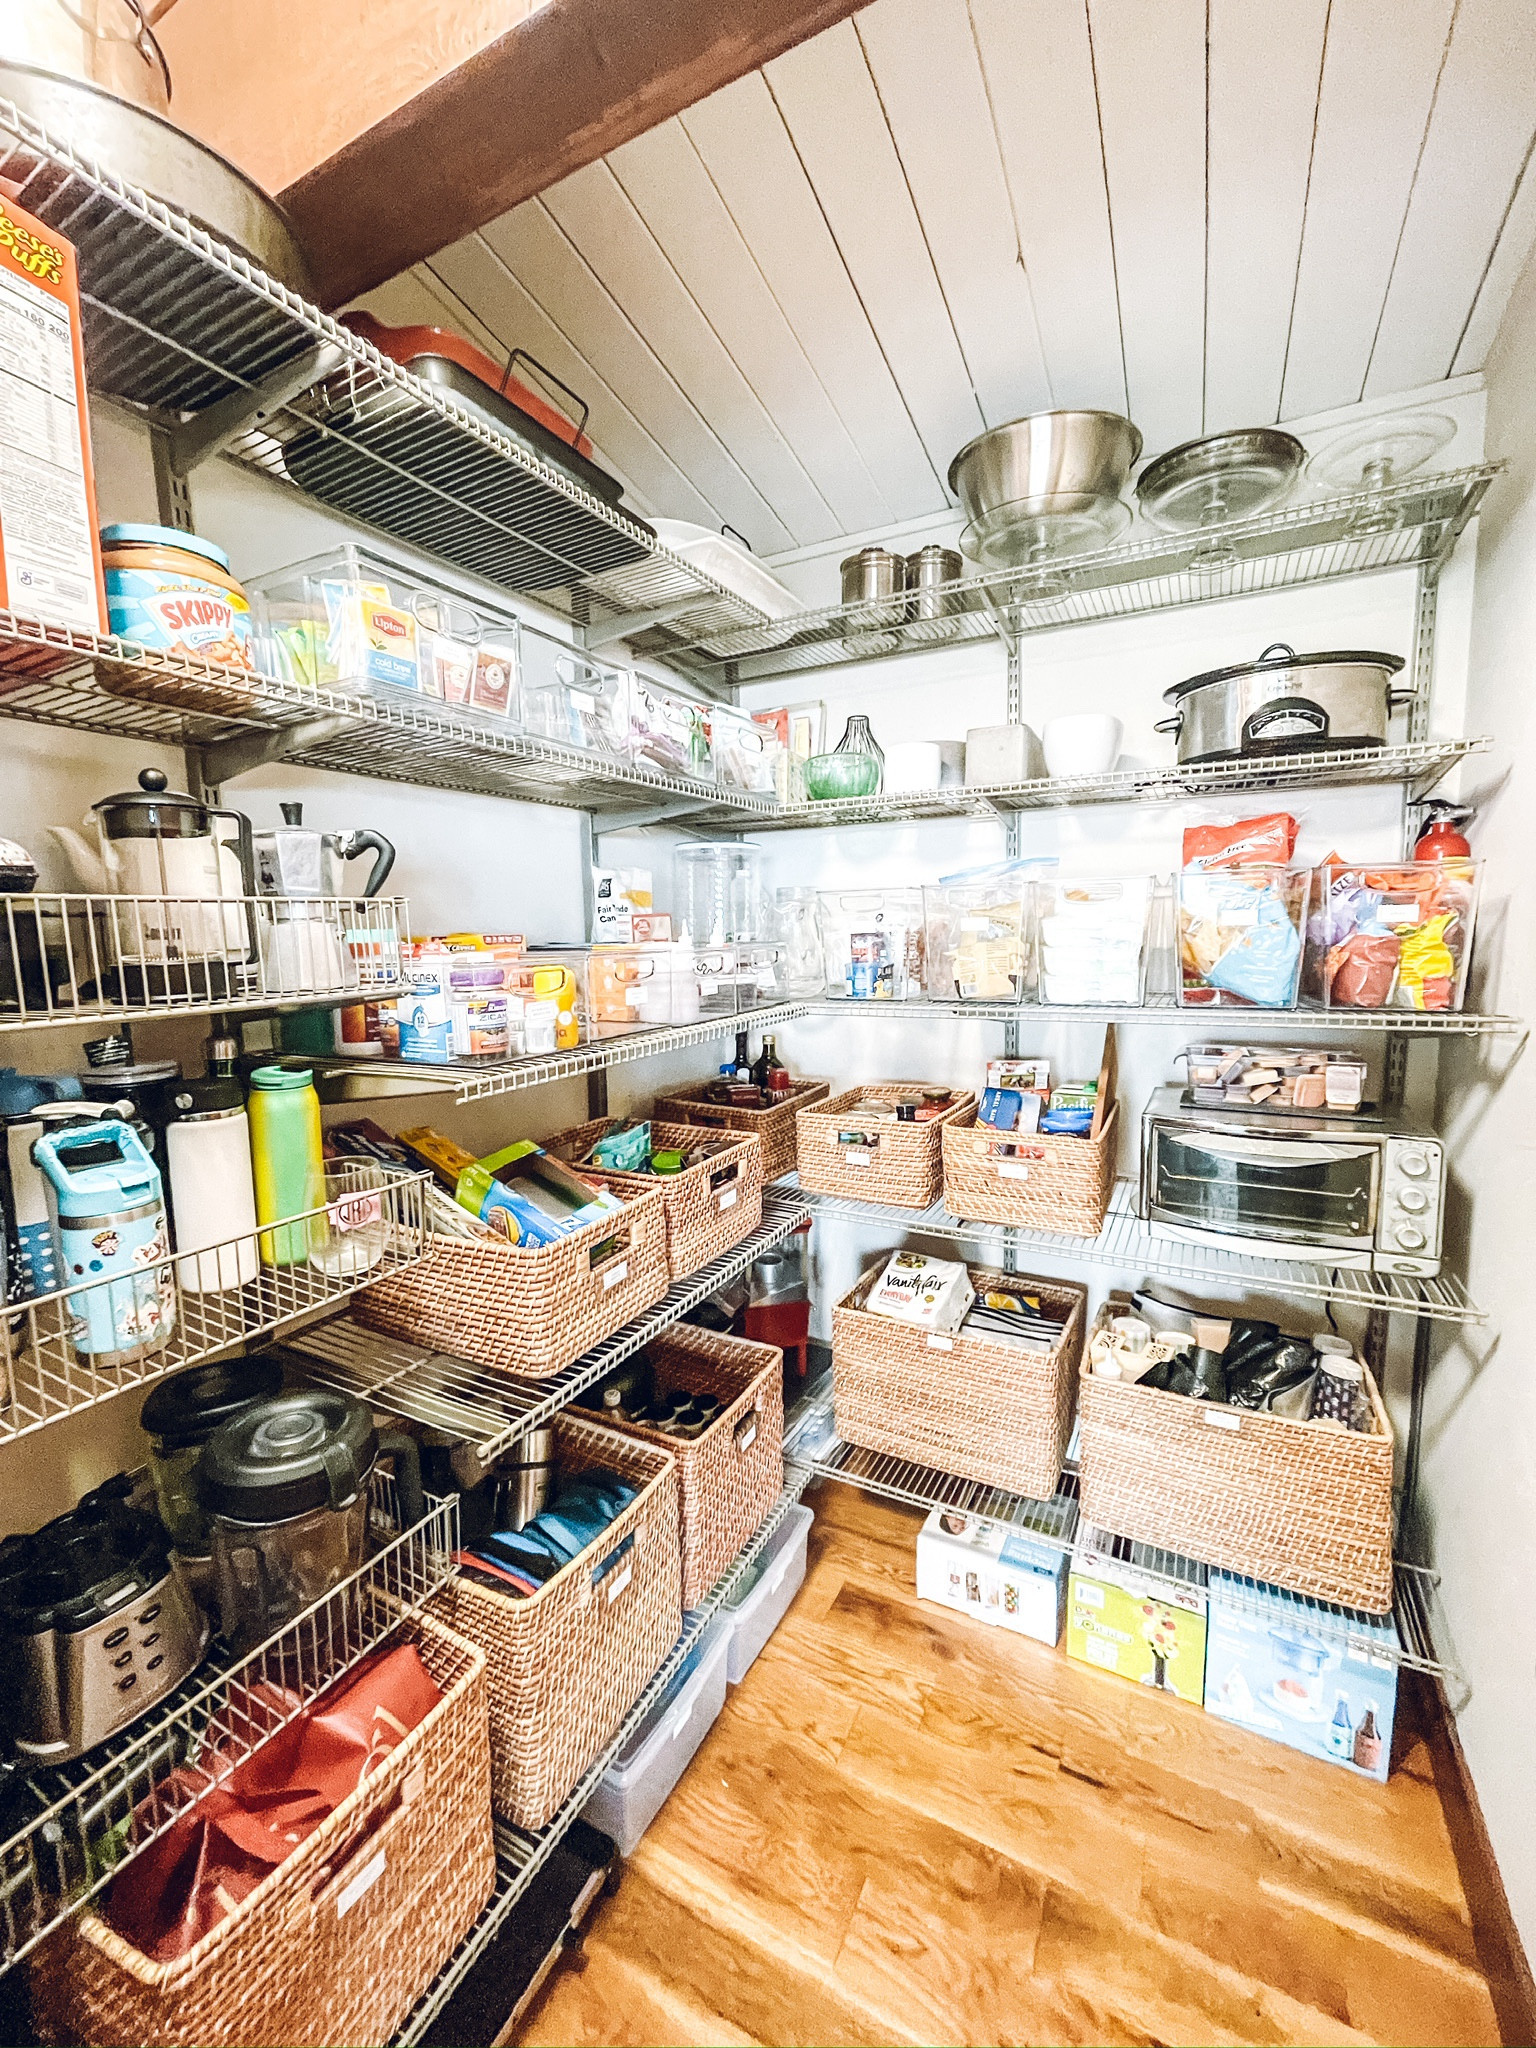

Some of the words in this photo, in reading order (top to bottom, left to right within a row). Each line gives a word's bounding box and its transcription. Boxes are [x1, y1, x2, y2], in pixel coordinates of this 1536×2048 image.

[0, 204, 64, 267] eese's
[49, 323, 70, 342] 200
[160, 600, 231, 629] SKIPPY
[375, 616, 405, 635] Lipton
[375, 657, 392, 669] cold
[393, 661, 412, 674] brew
[598, 905, 612, 914] Fair
[417, 1016, 425, 1024] 12
[886, 1274, 921, 1297] Vanity
